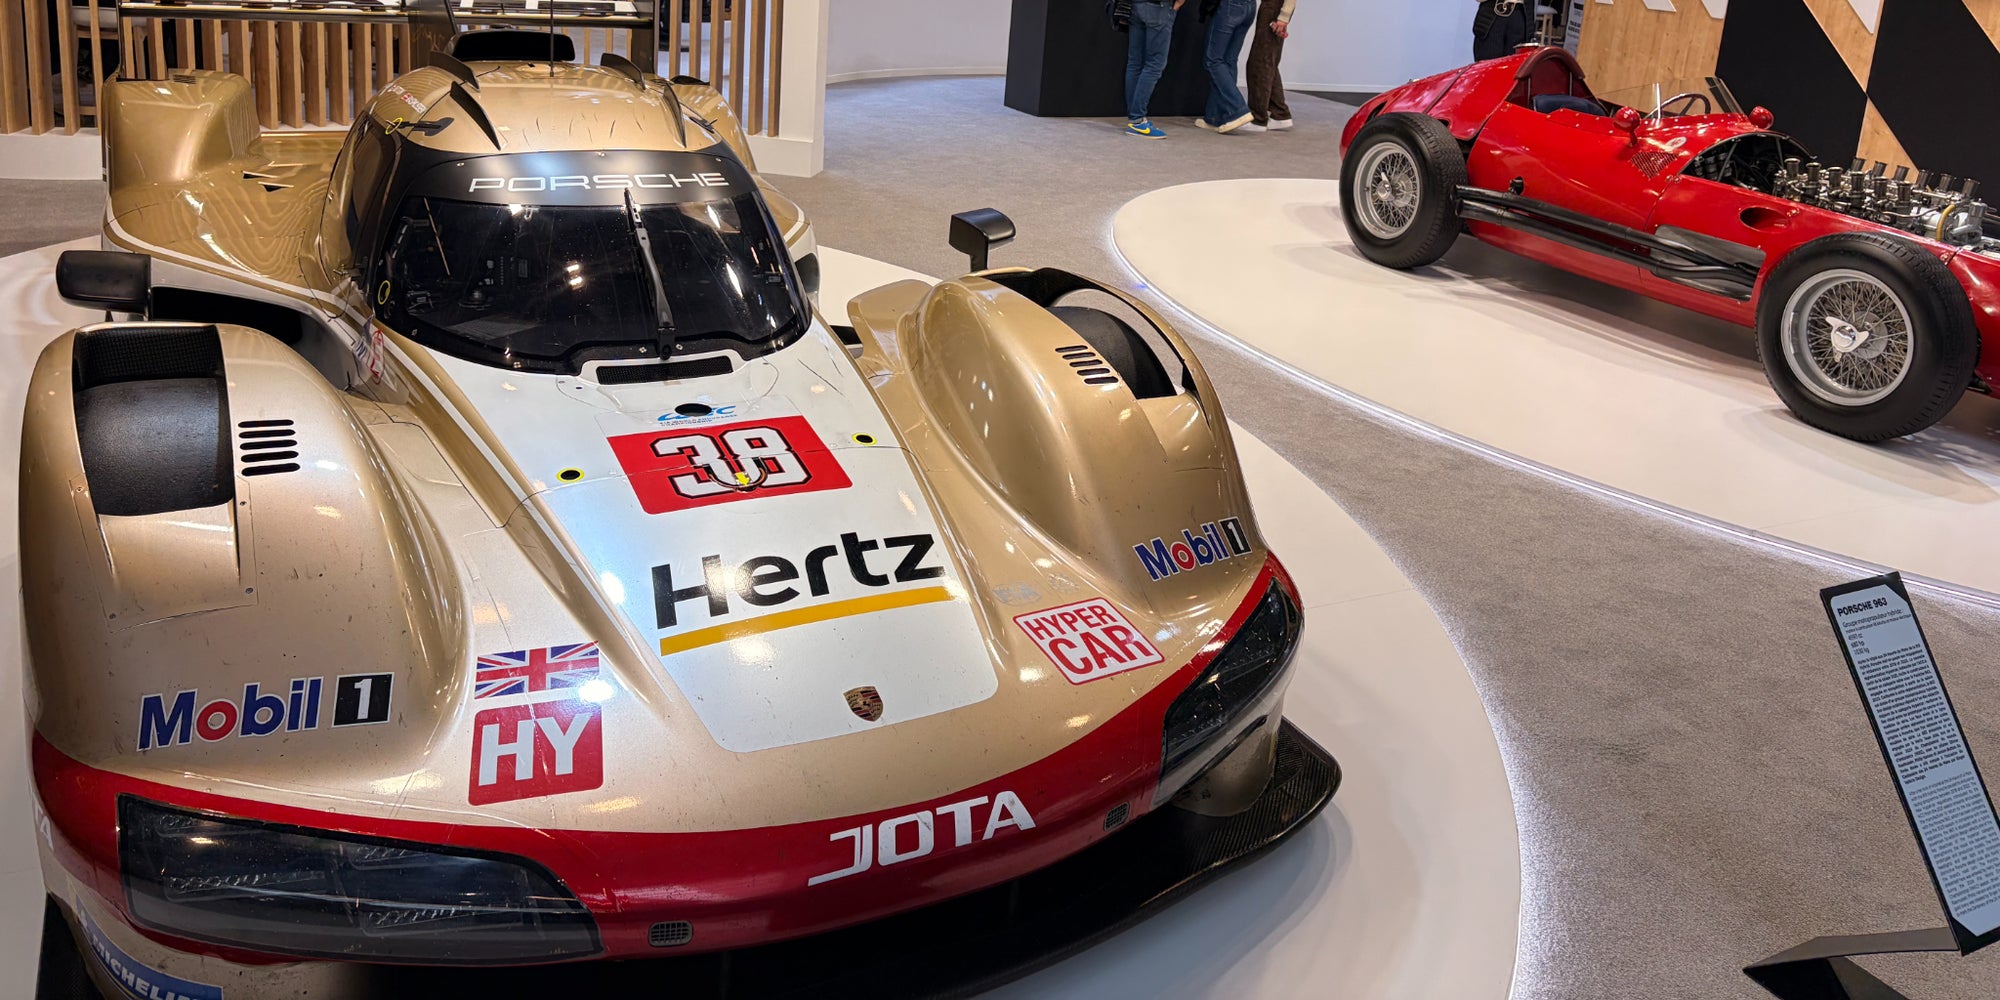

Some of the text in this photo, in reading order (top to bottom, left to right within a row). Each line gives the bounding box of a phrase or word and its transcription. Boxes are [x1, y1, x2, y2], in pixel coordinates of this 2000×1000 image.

[468, 172, 730, 193] PORSCHE
[651, 427, 813, 499] 38
[651, 531, 946, 629] Hertz
[1133, 522, 1230, 581] Mobil
[1024, 605, 1118, 641] HYPER
[1837, 597, 1888, 617] PORSCHE 963
[1049, 625, 1154, 675] CAR
[136, 677, 322, 751] Mobil
[478, 712, 593, 786] HY
[807, 790, 1037, 887] JOTA
